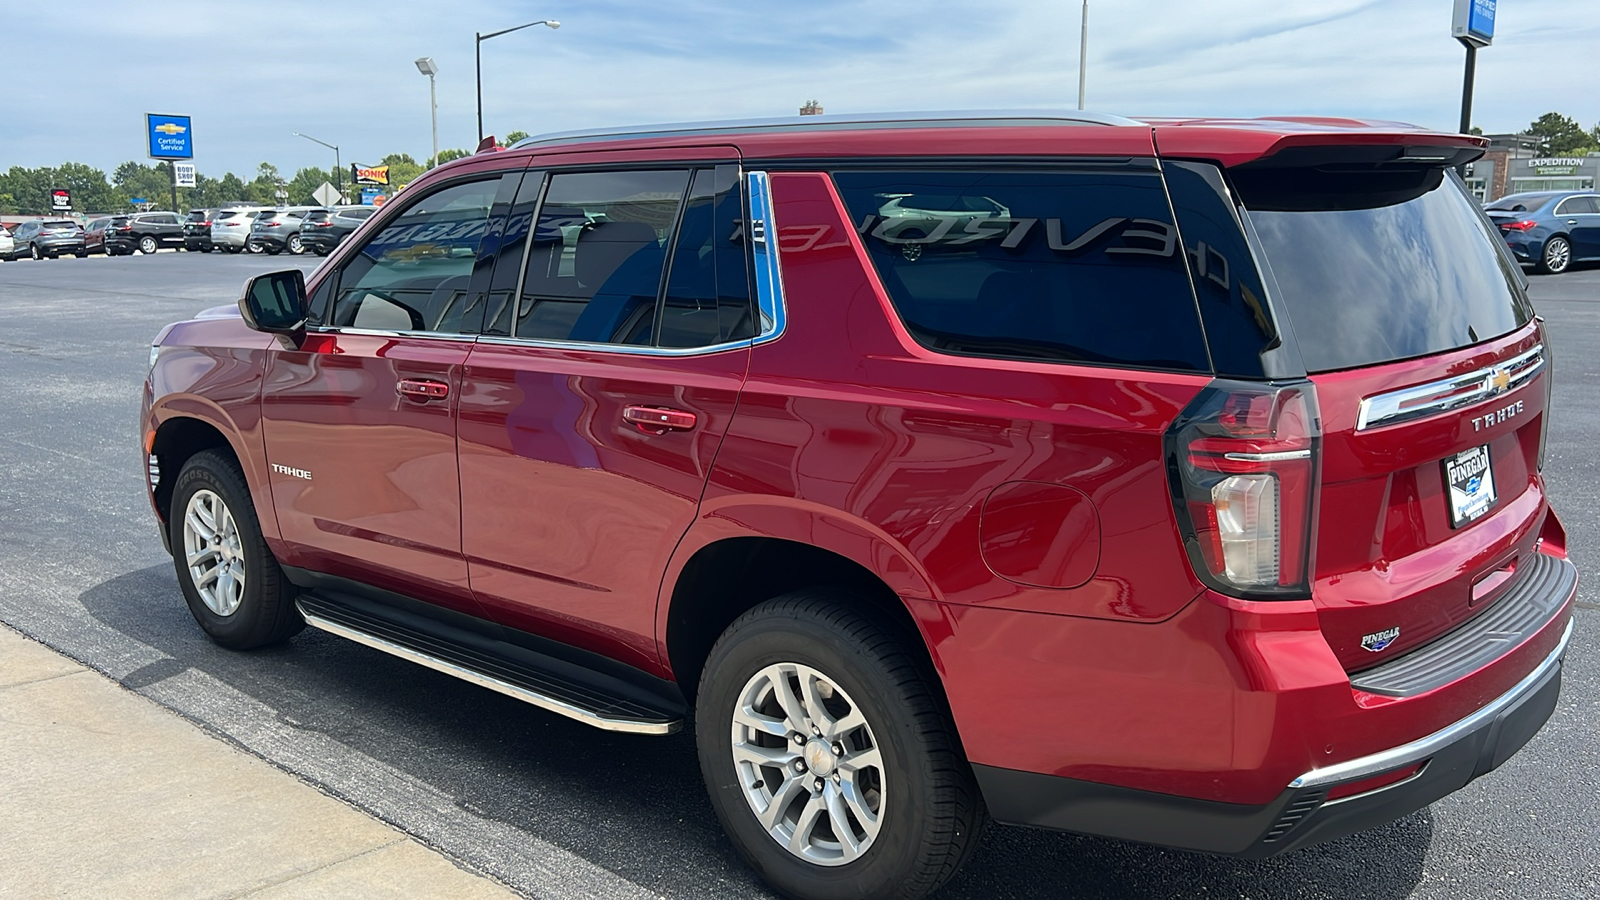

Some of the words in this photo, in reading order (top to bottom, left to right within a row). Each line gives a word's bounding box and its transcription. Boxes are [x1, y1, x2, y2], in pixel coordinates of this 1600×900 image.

[157, 137, 185, 146] Certified
[1528, 158, 1584, 168] EXPEDITION
[358, 169, 386, 179] SONIC
[1471, 400, 1524, 432] TAHOE
[271, 463, 312, 480] TAHOE
[1450, 454, 1488, 485] PINEGAR
[1361, 626, 1400, 646] PINEGAR
